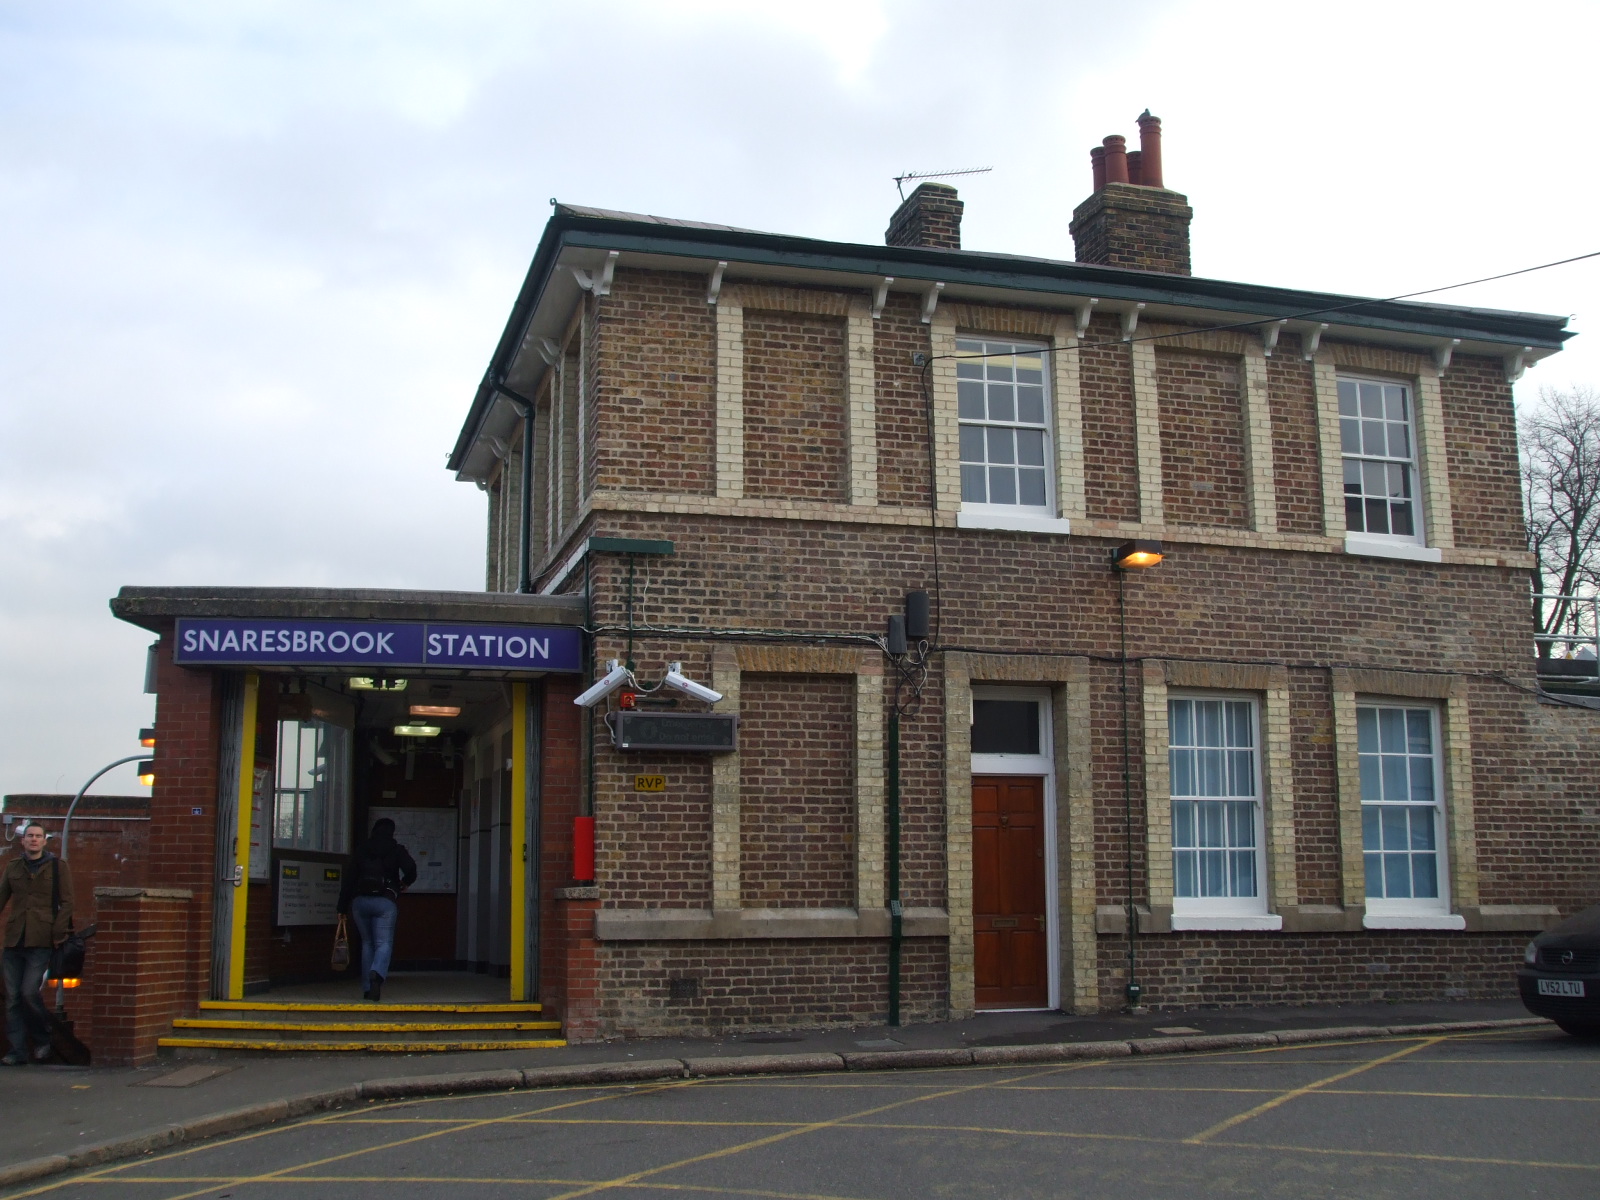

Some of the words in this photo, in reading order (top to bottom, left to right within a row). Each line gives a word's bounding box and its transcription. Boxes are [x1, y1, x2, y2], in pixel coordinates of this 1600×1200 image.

[183, 629, 395, 654] SNARESBROOK
[427, 633, 549, 659] STATION
[637, 777, 663, 788] RVP
[1540, 981, 1560, 993] LY52
[1562, 982, 1580, 994] LTU
